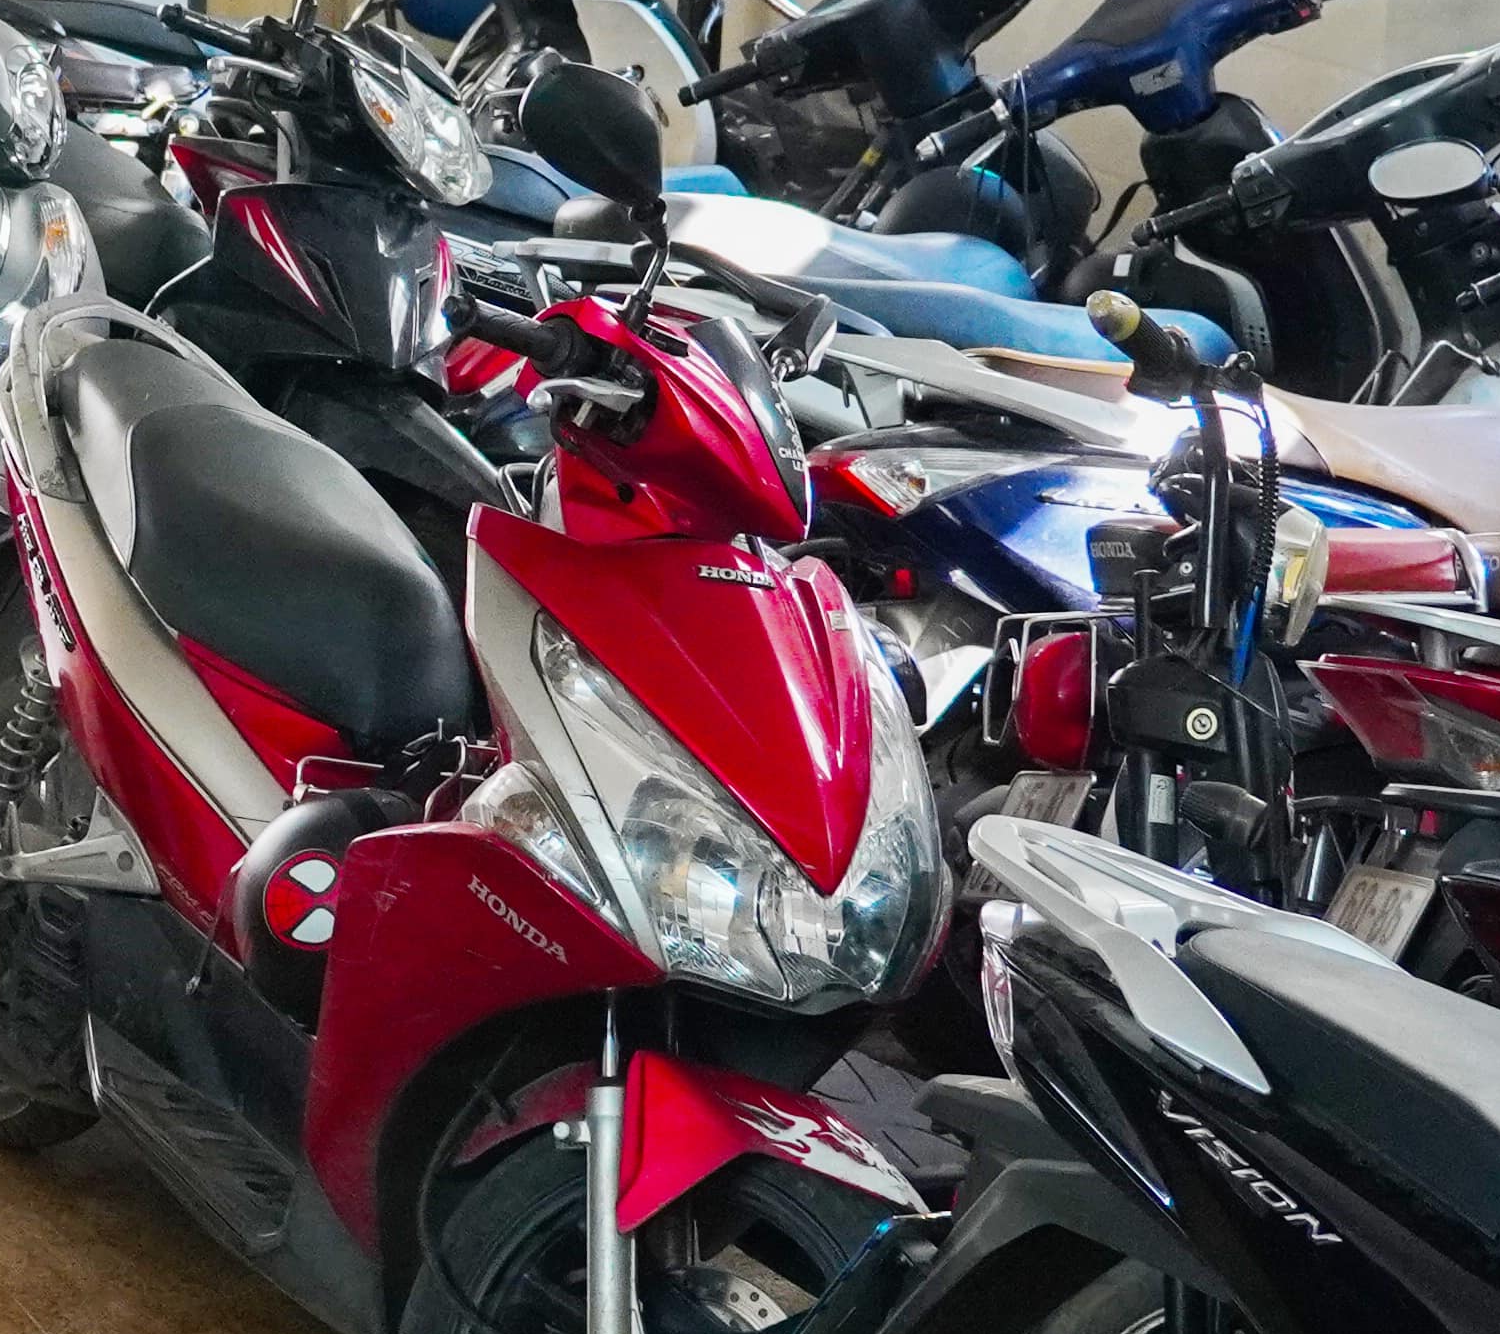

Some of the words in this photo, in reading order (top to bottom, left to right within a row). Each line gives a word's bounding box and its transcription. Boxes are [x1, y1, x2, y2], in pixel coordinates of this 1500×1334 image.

[698, 564, 777, 590] HONDA
[1091, 541, 1136, 559] HONDA
[467, 873, 568, 965] HONDA
[1157, 1090, 1343, 1243] VISION
